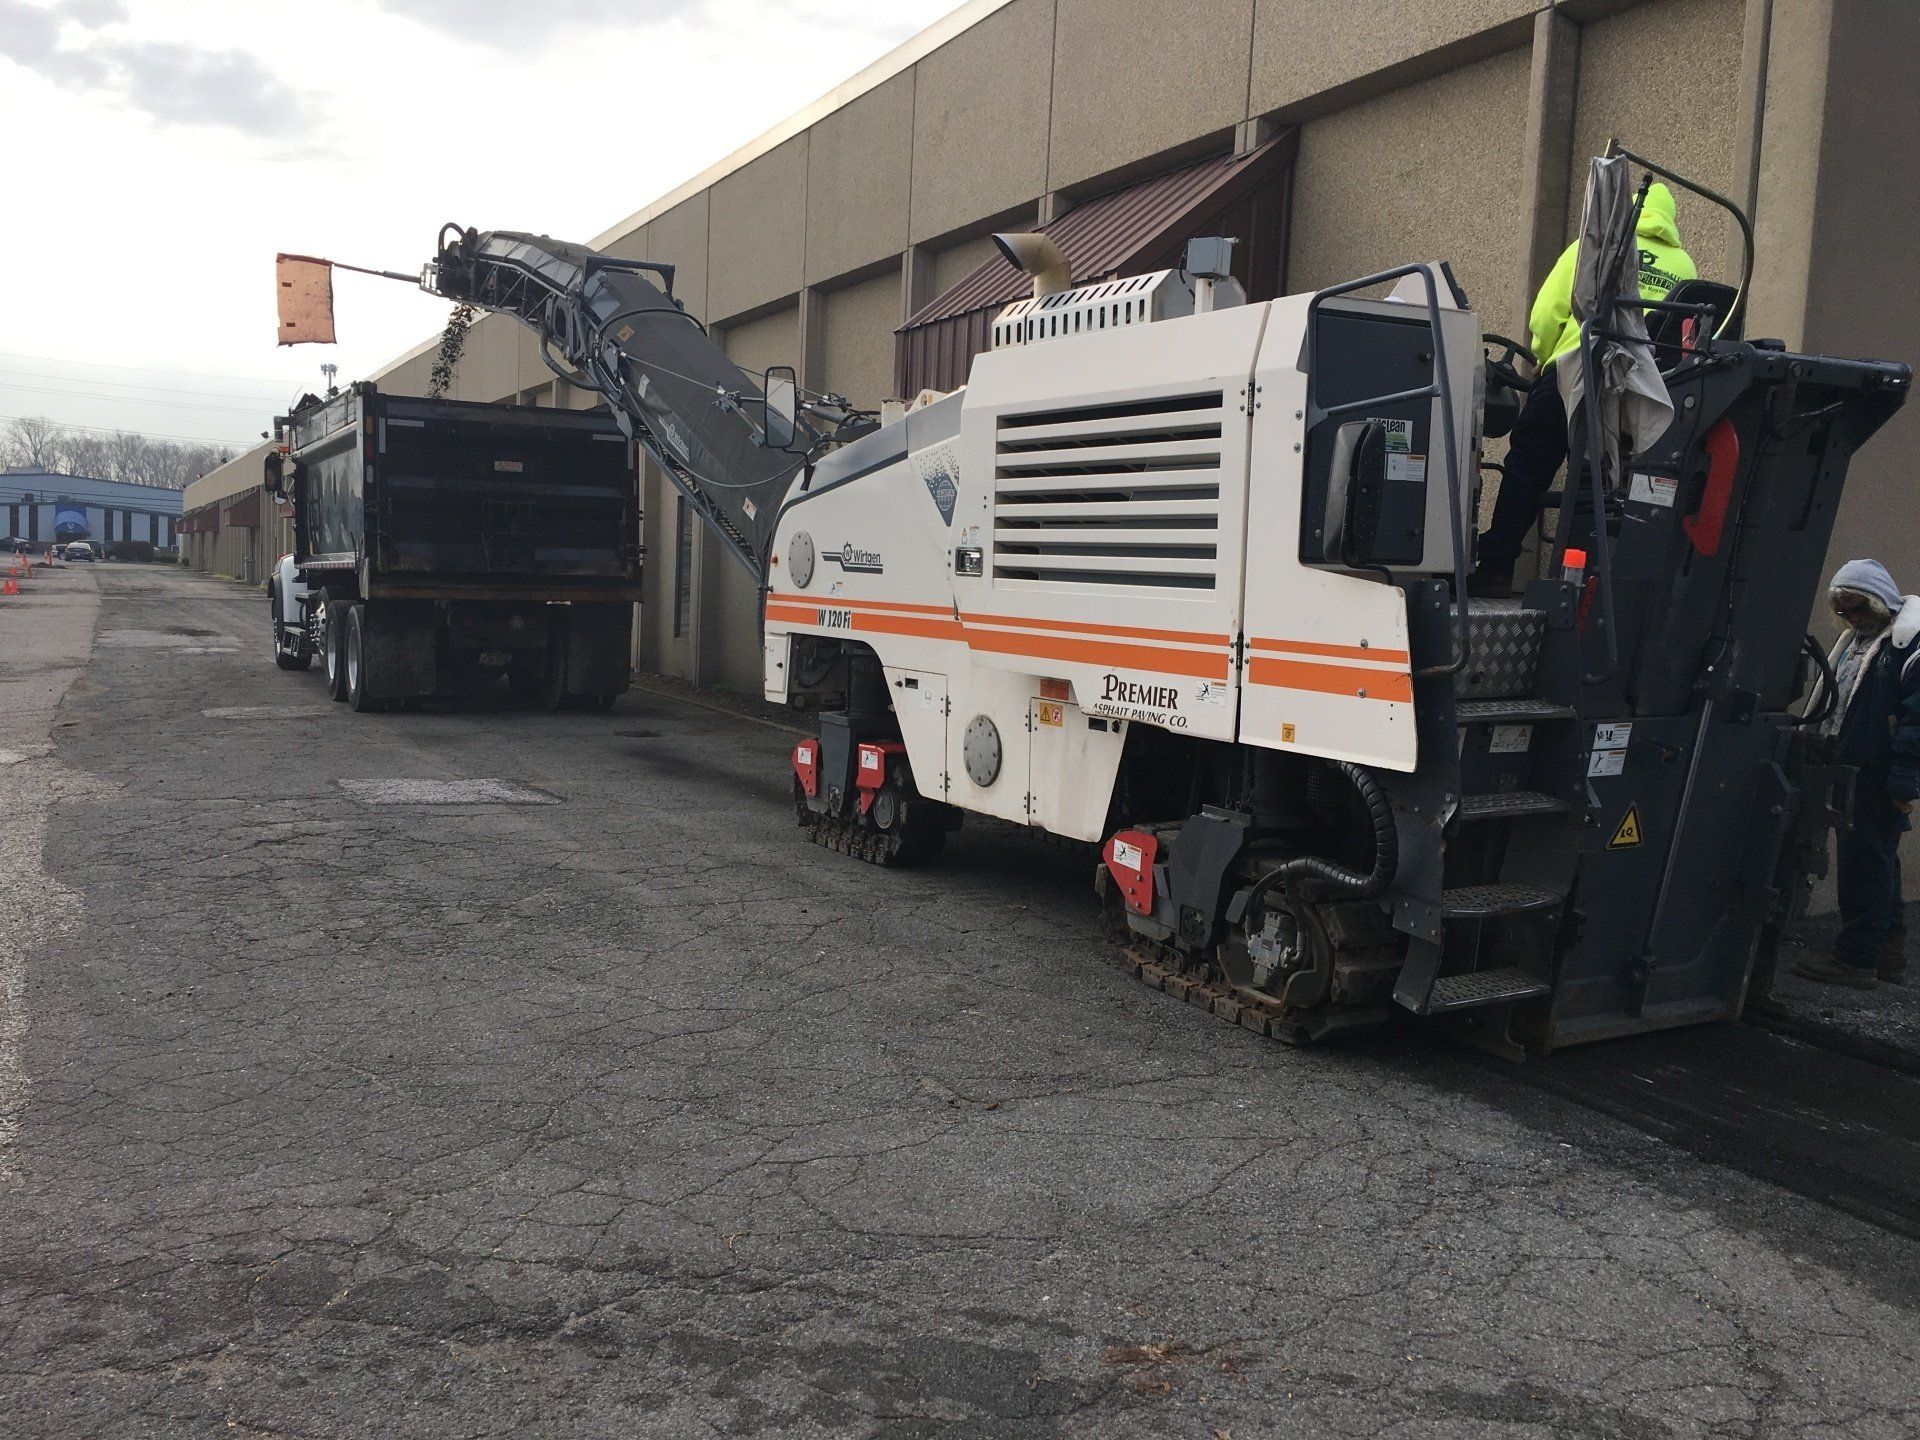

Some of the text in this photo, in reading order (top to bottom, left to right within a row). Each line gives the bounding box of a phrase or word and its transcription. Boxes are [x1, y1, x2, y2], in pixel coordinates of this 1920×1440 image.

[853, 549, 881, 566] Wirtgen
[818, 608, 827, 626] W
[1131, 709, 1167, 724] PAVING
[1169, 715, 1188, 728] CO.
